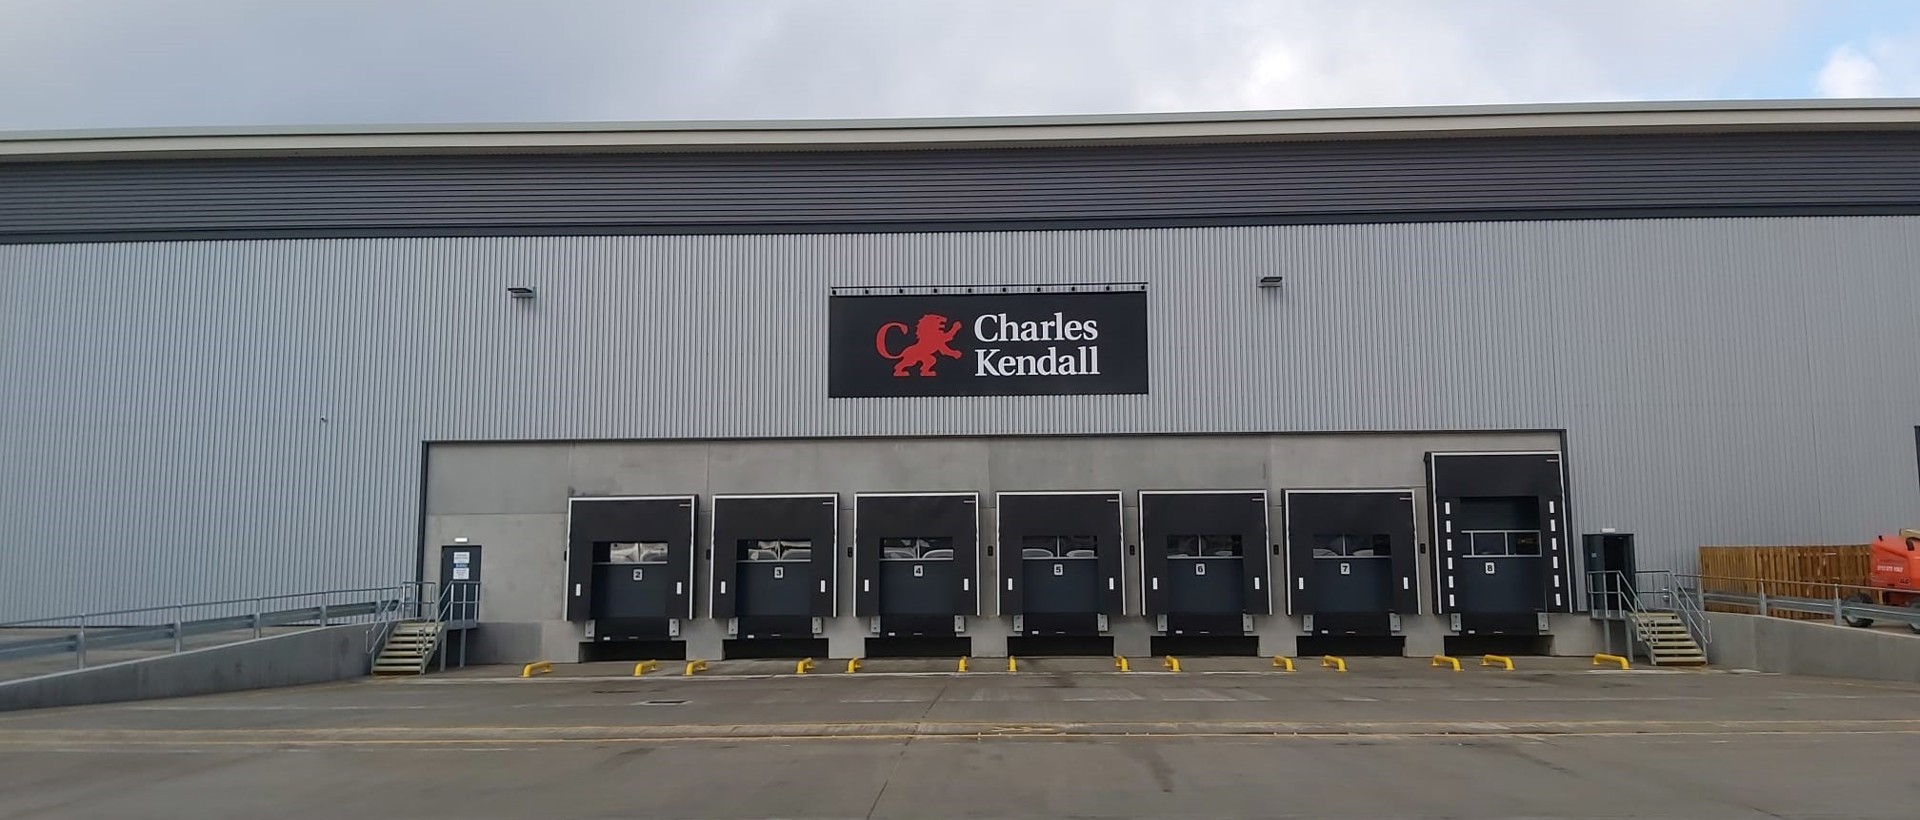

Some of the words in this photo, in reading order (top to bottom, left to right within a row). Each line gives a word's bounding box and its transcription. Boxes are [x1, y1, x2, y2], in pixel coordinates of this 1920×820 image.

[876, 322, 908, 359] C
[974, 312, 1098, 342] Charles
[975, 346, 1100, 376] Kendall
